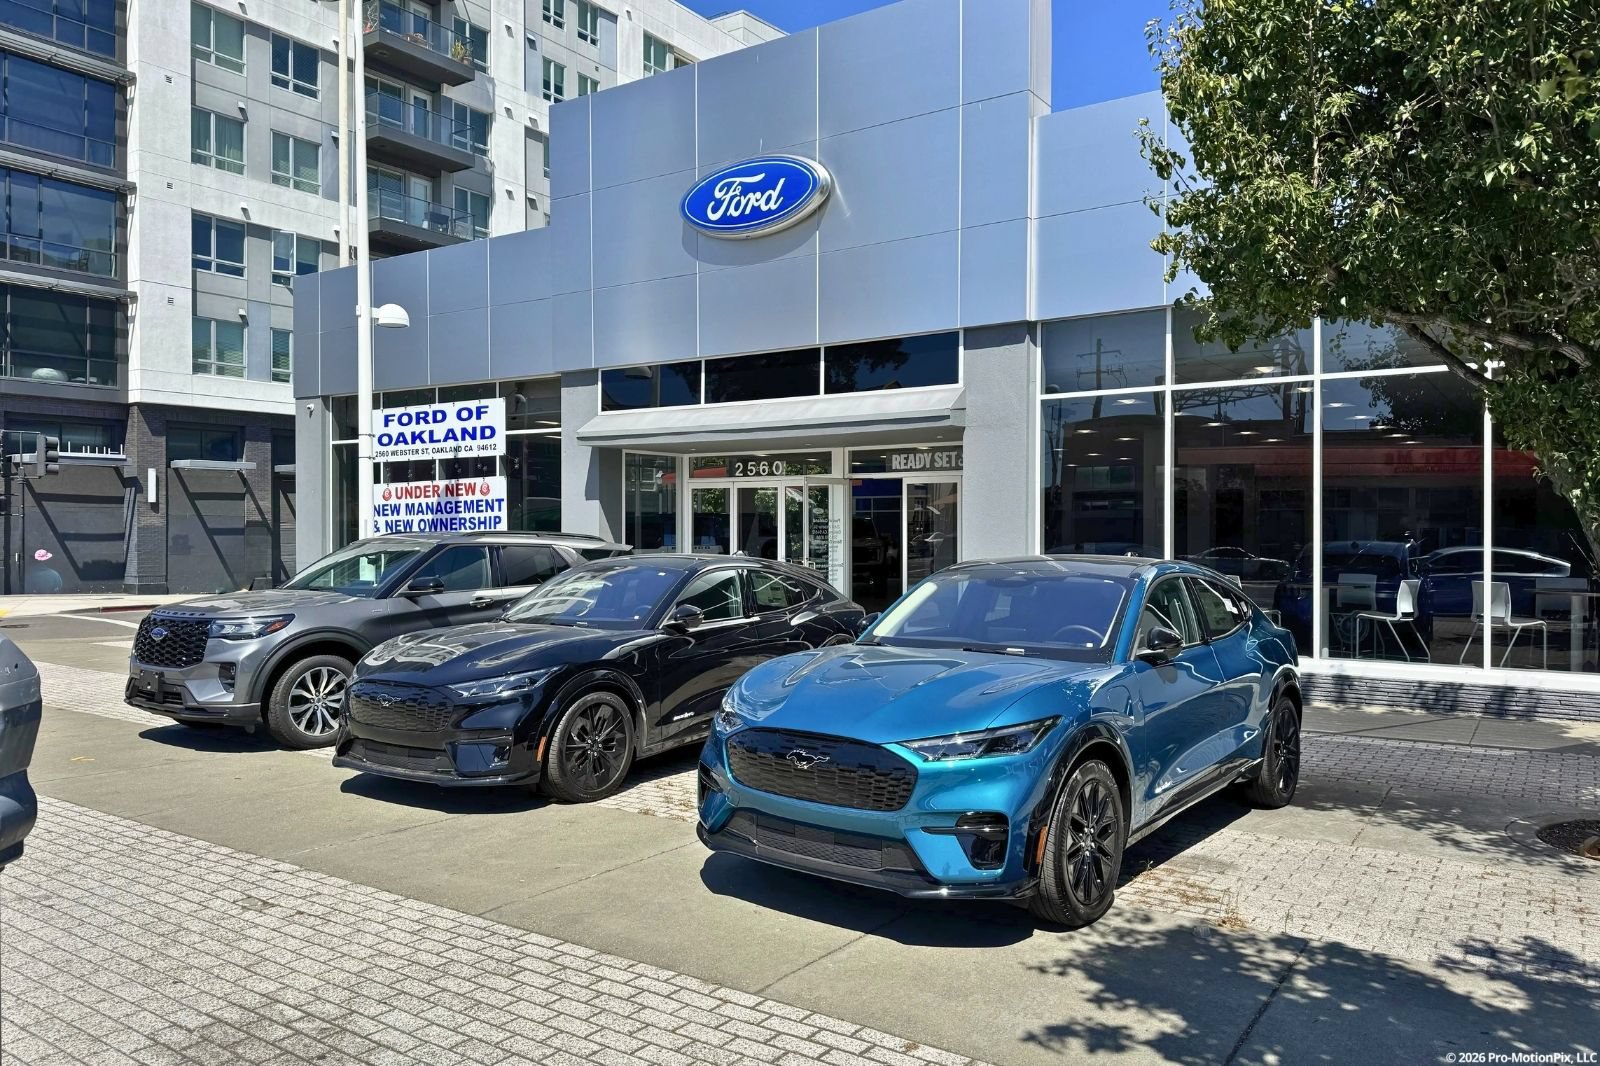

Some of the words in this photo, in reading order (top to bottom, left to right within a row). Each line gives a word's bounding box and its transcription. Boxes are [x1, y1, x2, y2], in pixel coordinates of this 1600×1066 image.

[707, 172, 786, 221] Ford
[383, 409, 447, 428] FORD
[456, 405, 489, 422] OF
[377, 425, 497, 447] OAKLAND
[375, 450, 389, 458] 2560
[390, 448, 420, 457] WEBSTER
[431, 445, 463, 454] OAKLAND
[463, 444, 474, 452] CA
[476, 443, 497, 451] 94612
[735, 460, 783, 477] 2560
[891, 452, 933, 470] READY
[933, 451, 958, 468] SET
[395, 484, 441, 500] UNDER
[445, 482, 477, 498] NEW
[373, 503, 402, 517] NEW
[405, 498, 505, 516] MANAGEMENT
[373, 520, 381, 533] &
[385, 518, 414, 533] NEW
[417, 515, 502, 533] OWNERSHIP
